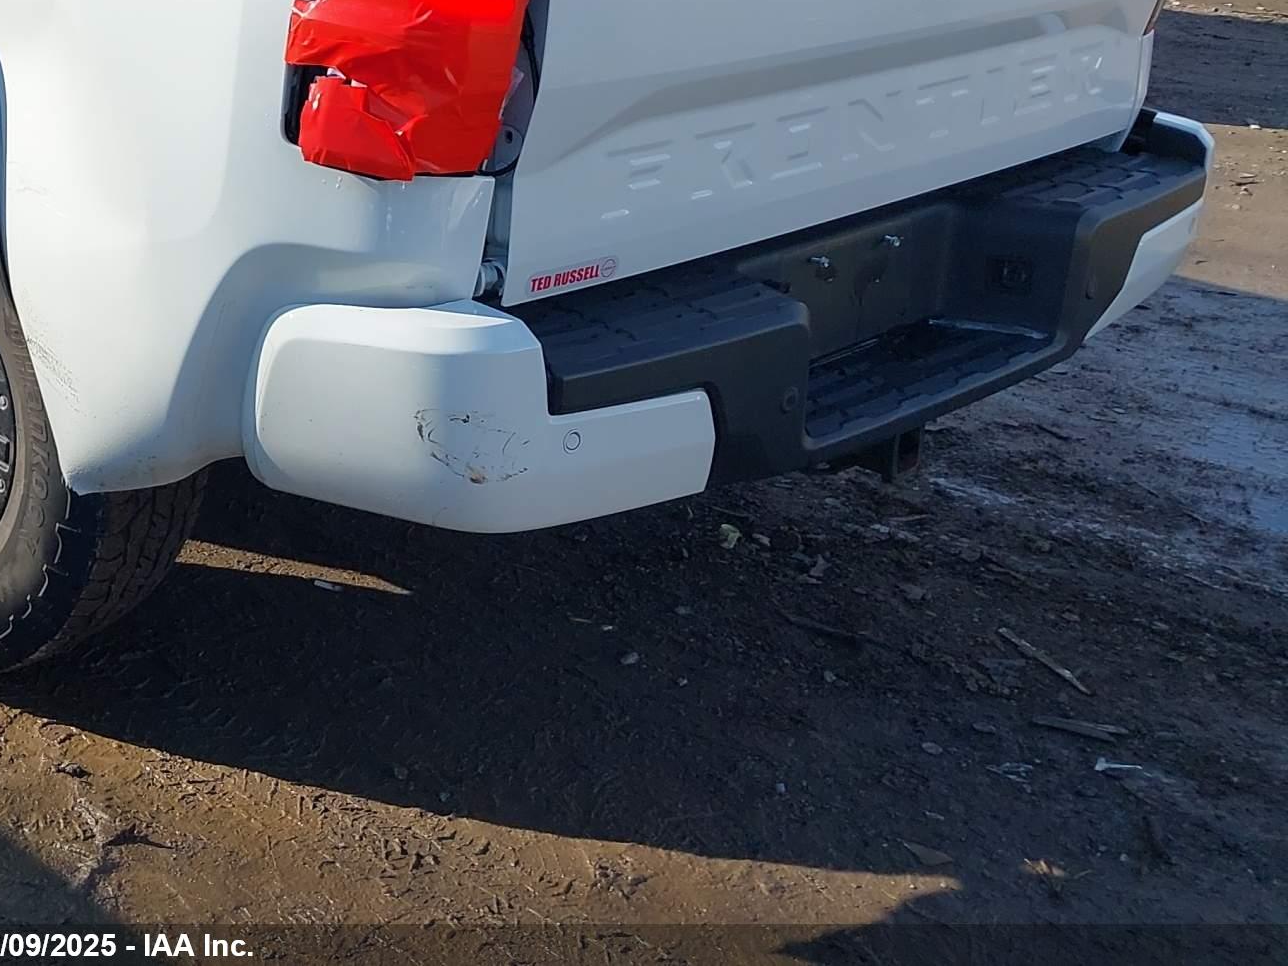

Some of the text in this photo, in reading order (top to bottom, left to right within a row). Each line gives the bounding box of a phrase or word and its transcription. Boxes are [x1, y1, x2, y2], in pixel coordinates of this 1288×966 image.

[600, 46, 1105, 220] FRONTIER
[530, 275, 552, 292] TED
[553, 265, 600, 286] RUSSELL
